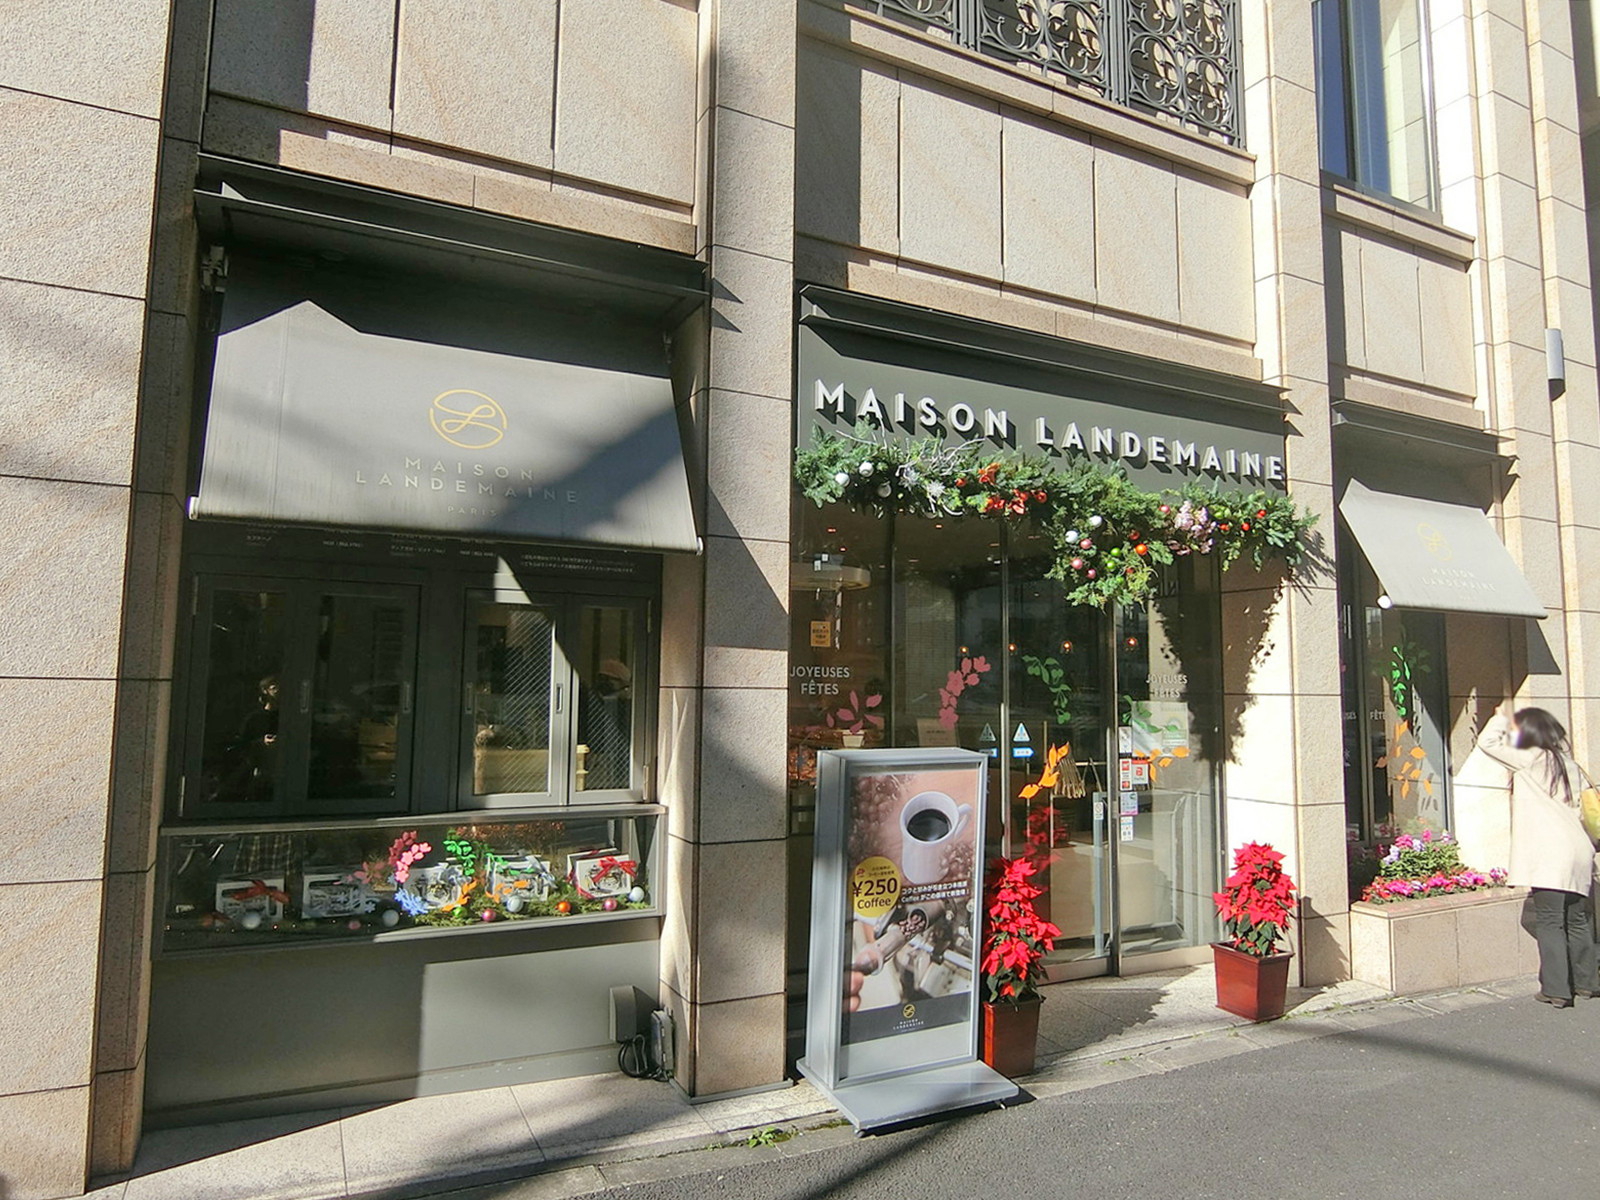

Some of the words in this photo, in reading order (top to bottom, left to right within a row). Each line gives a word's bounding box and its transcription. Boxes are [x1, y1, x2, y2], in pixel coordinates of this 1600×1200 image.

[814, 378, 1008, 440] MAISON
[1035, 416, 1285, 481] LANDEMAINE
[404, 456, 533, 481] MAISON
[355, 470, 577, 503] LANDEMAINE
[447, 505, 497, 517] PARIS
[789, 665, 850, 678] JOYEUSES
[1145, 673, 1188, 685] JOYEUSES
[800, 680, 840, 695] FÊTES
[852, 877, 898, 898] ¥250
[857, 896, 892, 910] Coffee
